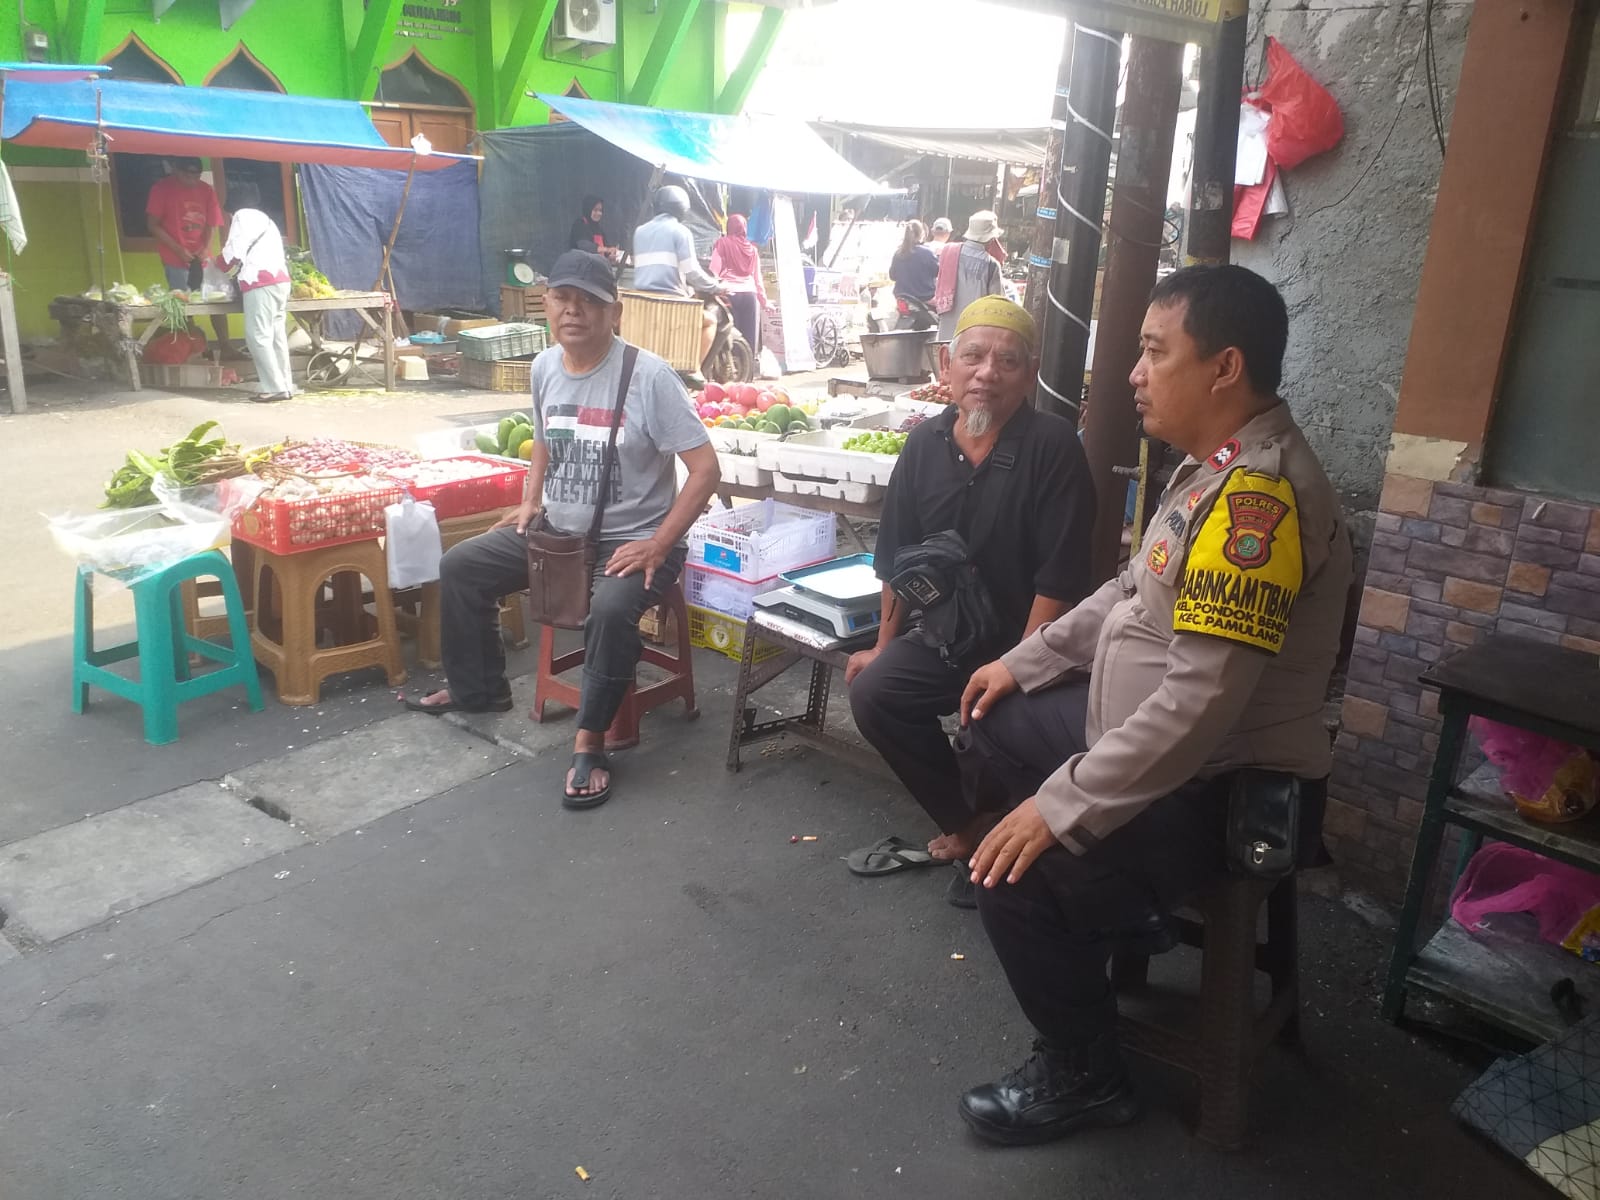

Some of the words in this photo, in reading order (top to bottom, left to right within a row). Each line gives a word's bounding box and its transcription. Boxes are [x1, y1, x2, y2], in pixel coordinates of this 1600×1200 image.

[1235, 497, 1279, 514] POLRES
[1193, 602, 1256, 624] PONDOK
[1205, 615, 1280, 645] PAMULANG
